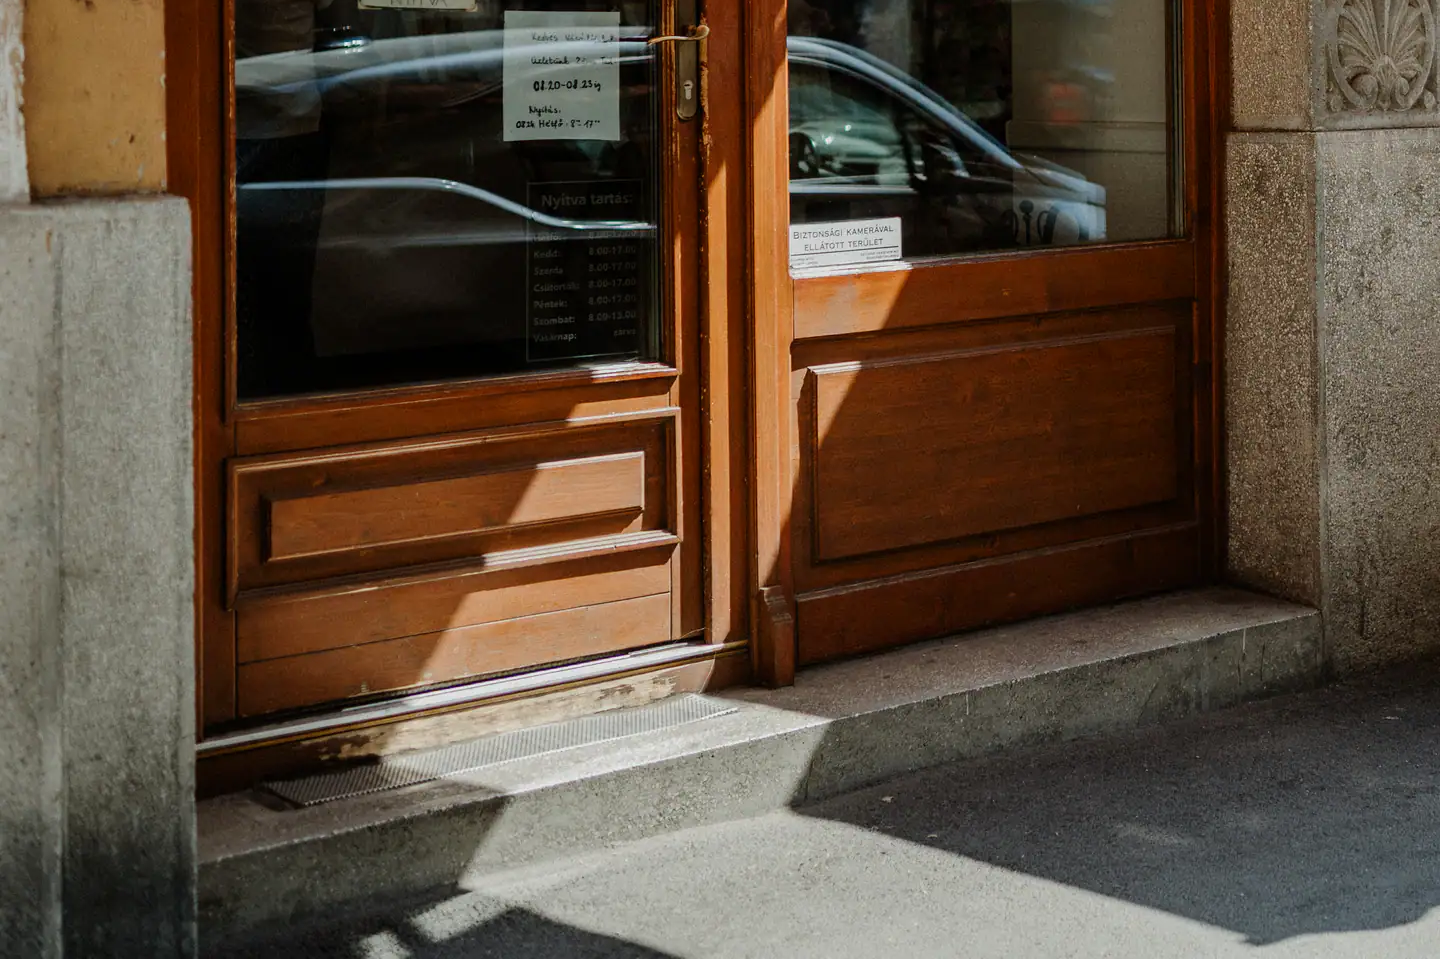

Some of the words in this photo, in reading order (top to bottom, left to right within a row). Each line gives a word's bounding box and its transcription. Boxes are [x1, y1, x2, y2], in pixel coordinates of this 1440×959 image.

[541, 194, 586, 209] Nyitva
[590, 192, 633, 205] tartás:
[793, 227, 843, 240] BIZTONSÁGI
[847, 224, 894, 236] KAMERÁVAL
[804, 241, 845, 252] ELLÁTOTT
[848, 238, 883, 248] TERÜLET
[533, 315, 575, 326] Szombat:
